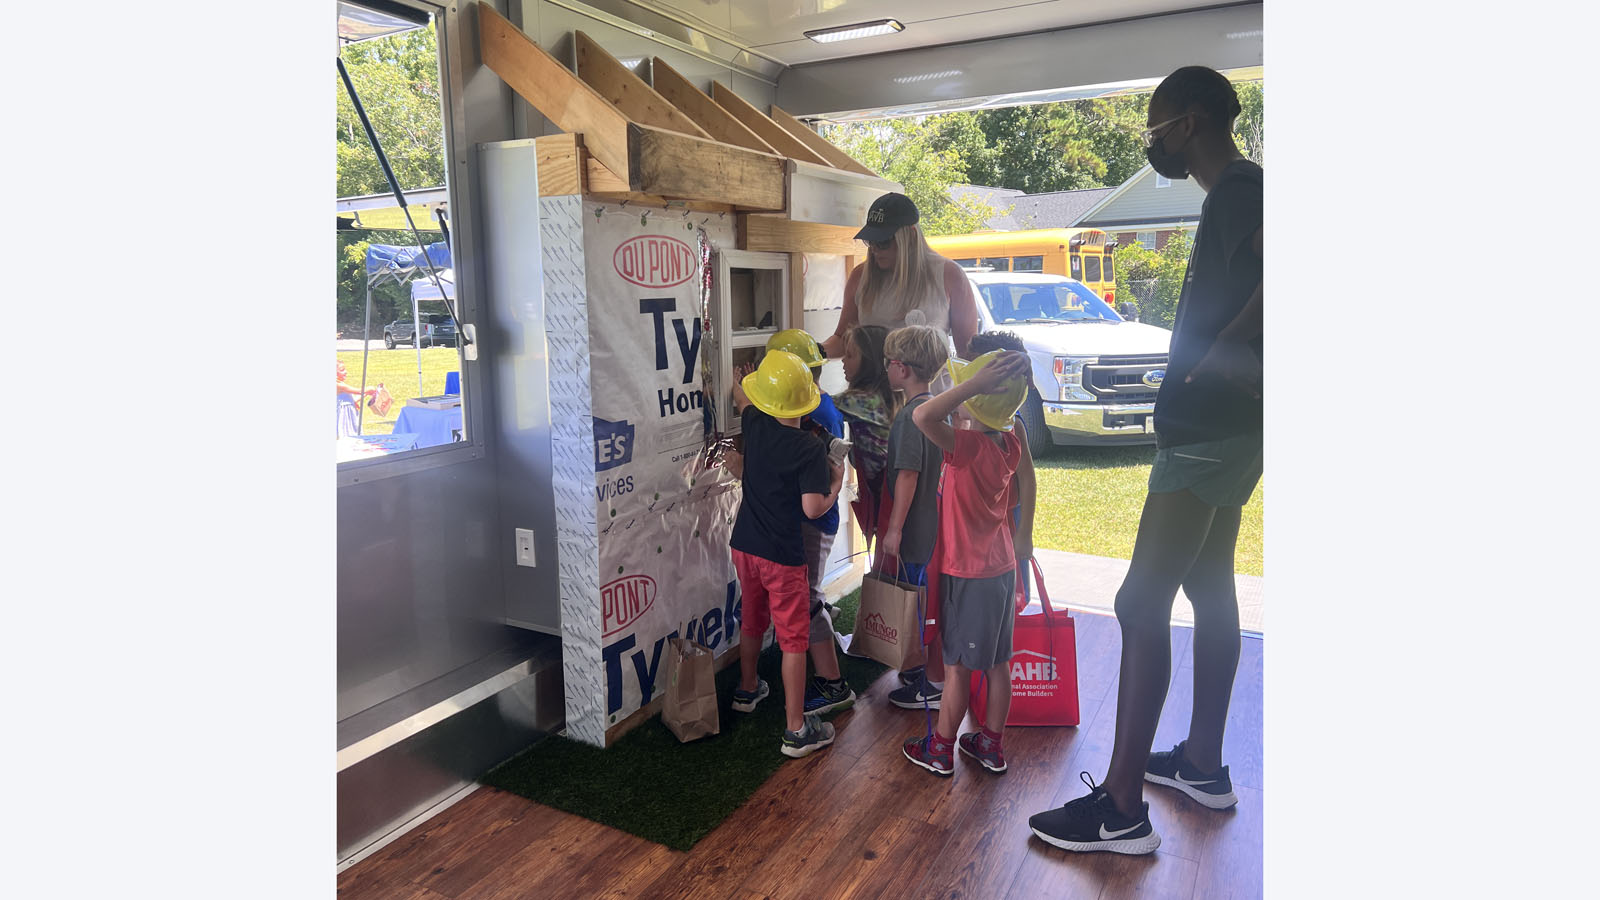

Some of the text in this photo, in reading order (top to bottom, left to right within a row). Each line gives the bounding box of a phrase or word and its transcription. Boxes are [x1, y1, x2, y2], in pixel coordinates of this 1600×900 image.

[595, 475, 634, 502] vices
[867, 620, 898, 638] MUNGO
[1022, 682, 1058, 690] Association
